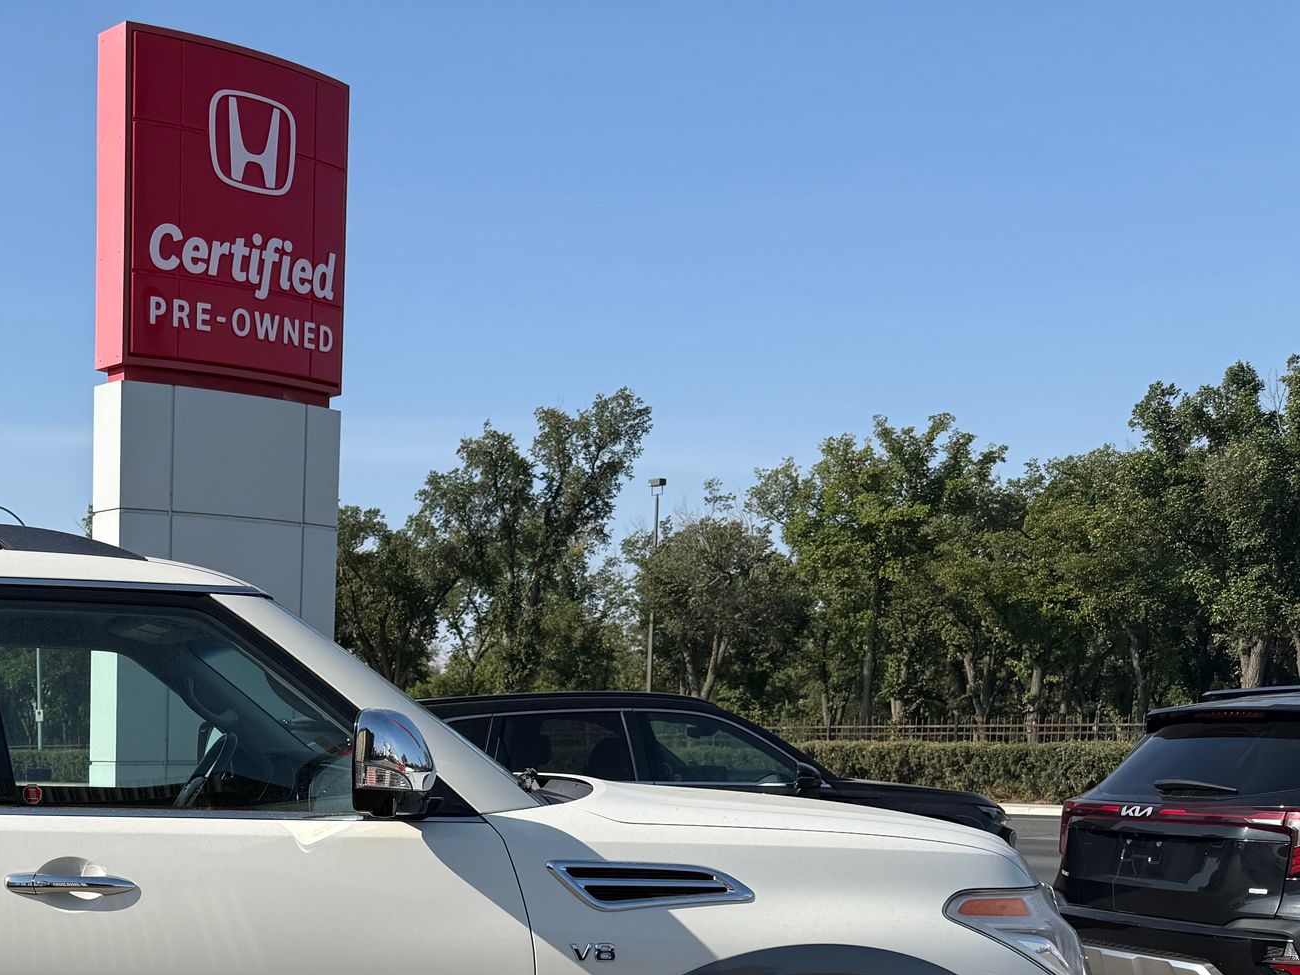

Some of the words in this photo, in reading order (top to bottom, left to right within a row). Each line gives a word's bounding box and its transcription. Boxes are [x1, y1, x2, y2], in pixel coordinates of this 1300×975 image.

[149, 222, 336, 301] Certified
[149, 295, 334, 353] PRE-OWNED
[569, 943, 616, 961] V8
